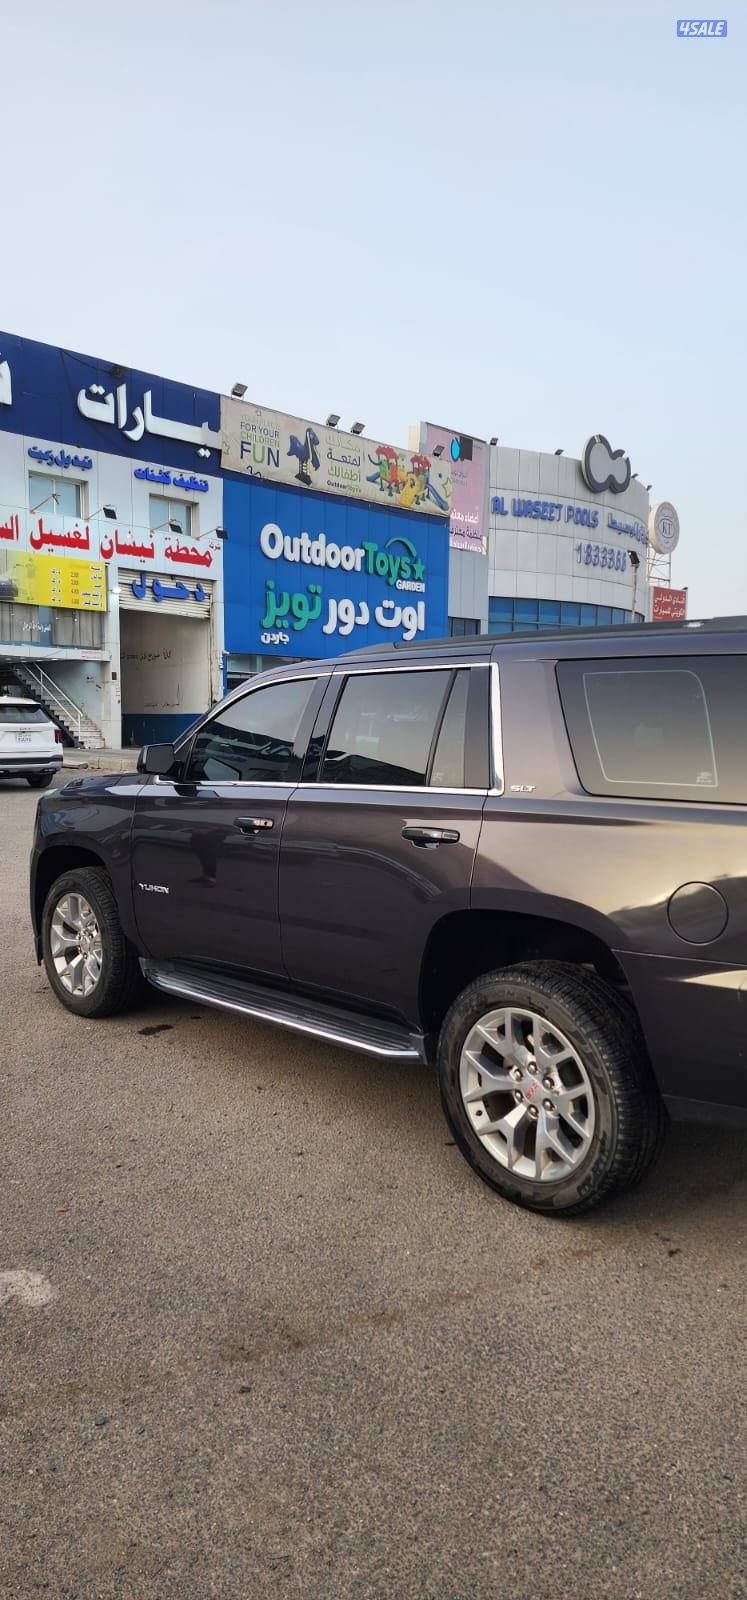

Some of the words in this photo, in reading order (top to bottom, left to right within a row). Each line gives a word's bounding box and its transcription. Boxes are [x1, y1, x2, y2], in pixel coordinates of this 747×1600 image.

[240, 421, 257, 434] FOR
[258, 426, 280, 439] YOUR
[240, 431, 280, 448] CHILDREN
[240, 440, 280, 468] FUN
[327, 448, 361, 467] لمتعة
[172, 473, 209, 493] تنظيف
[491, 496, 508, 517] AL
[512, 498, 563, 522] WASEET
[565, 505, 600, 529] POOLS
[29, 517, 90, 553] لغسيل
[100, 528, 155, 563] نيسان
[164, 536, 213, 568] محطة
[131, 570, 206, 603] دخول
[395, 579, 426, 593] GARDEN
[260, 578, 323, 631] تويز
[323, 598, 370, 636] دور
[375, 599, 426, 641] اوت
[260, 631, 290, 645] جاردن
[510, 785, 536, 793] SLT
[138, 882, 169, 894] YUKON
